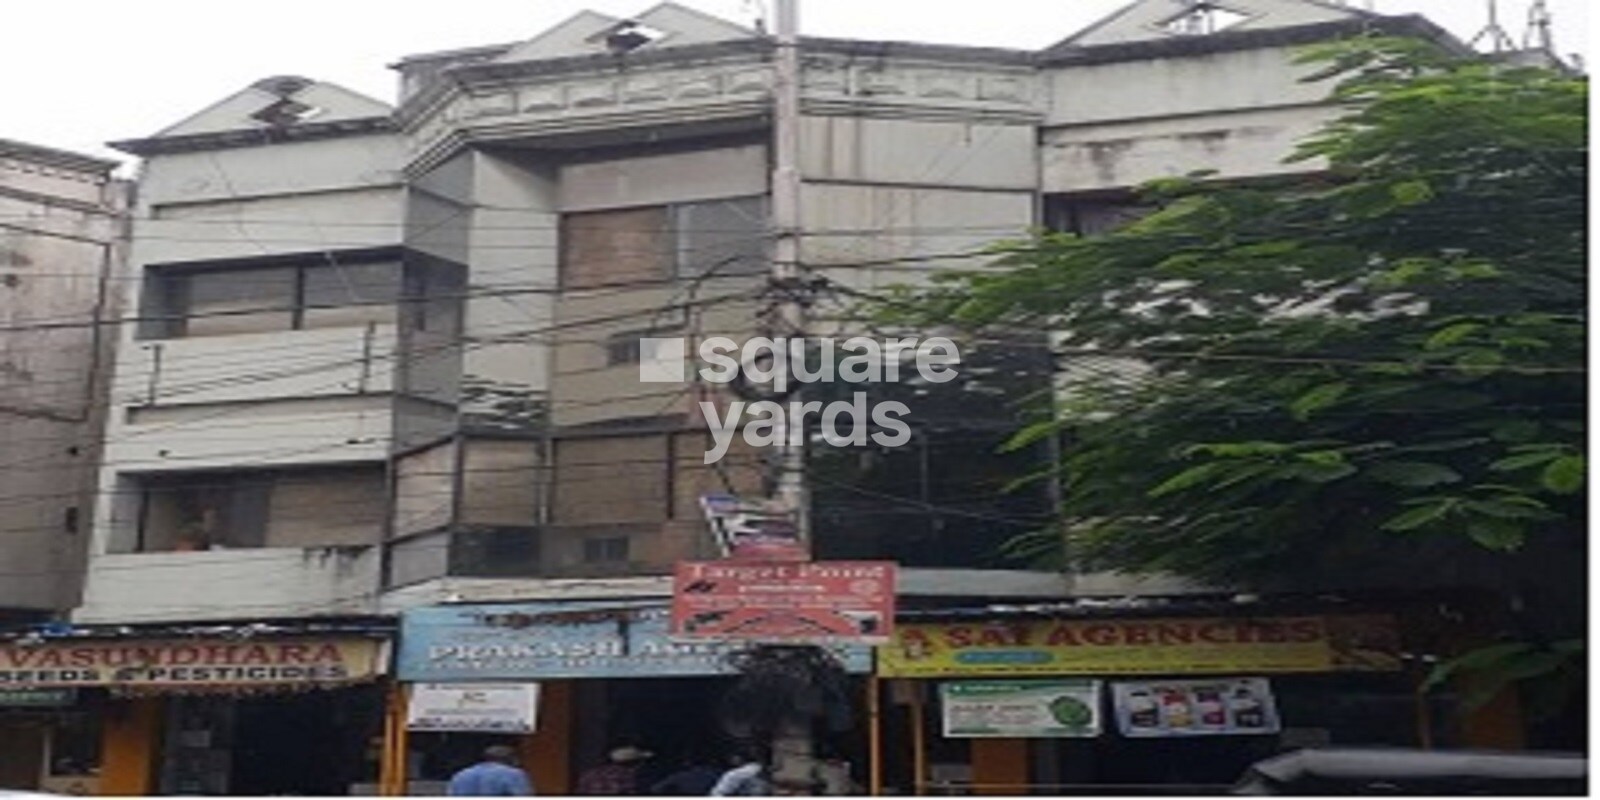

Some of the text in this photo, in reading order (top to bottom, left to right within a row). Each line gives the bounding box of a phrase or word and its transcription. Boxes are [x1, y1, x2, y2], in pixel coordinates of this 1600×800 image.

[1046, 621, 1320, 647] AGENCIES
[6, 644, 344, 667] VASUNDHARA
[149, 666, 347, 682] PESTICIDES
